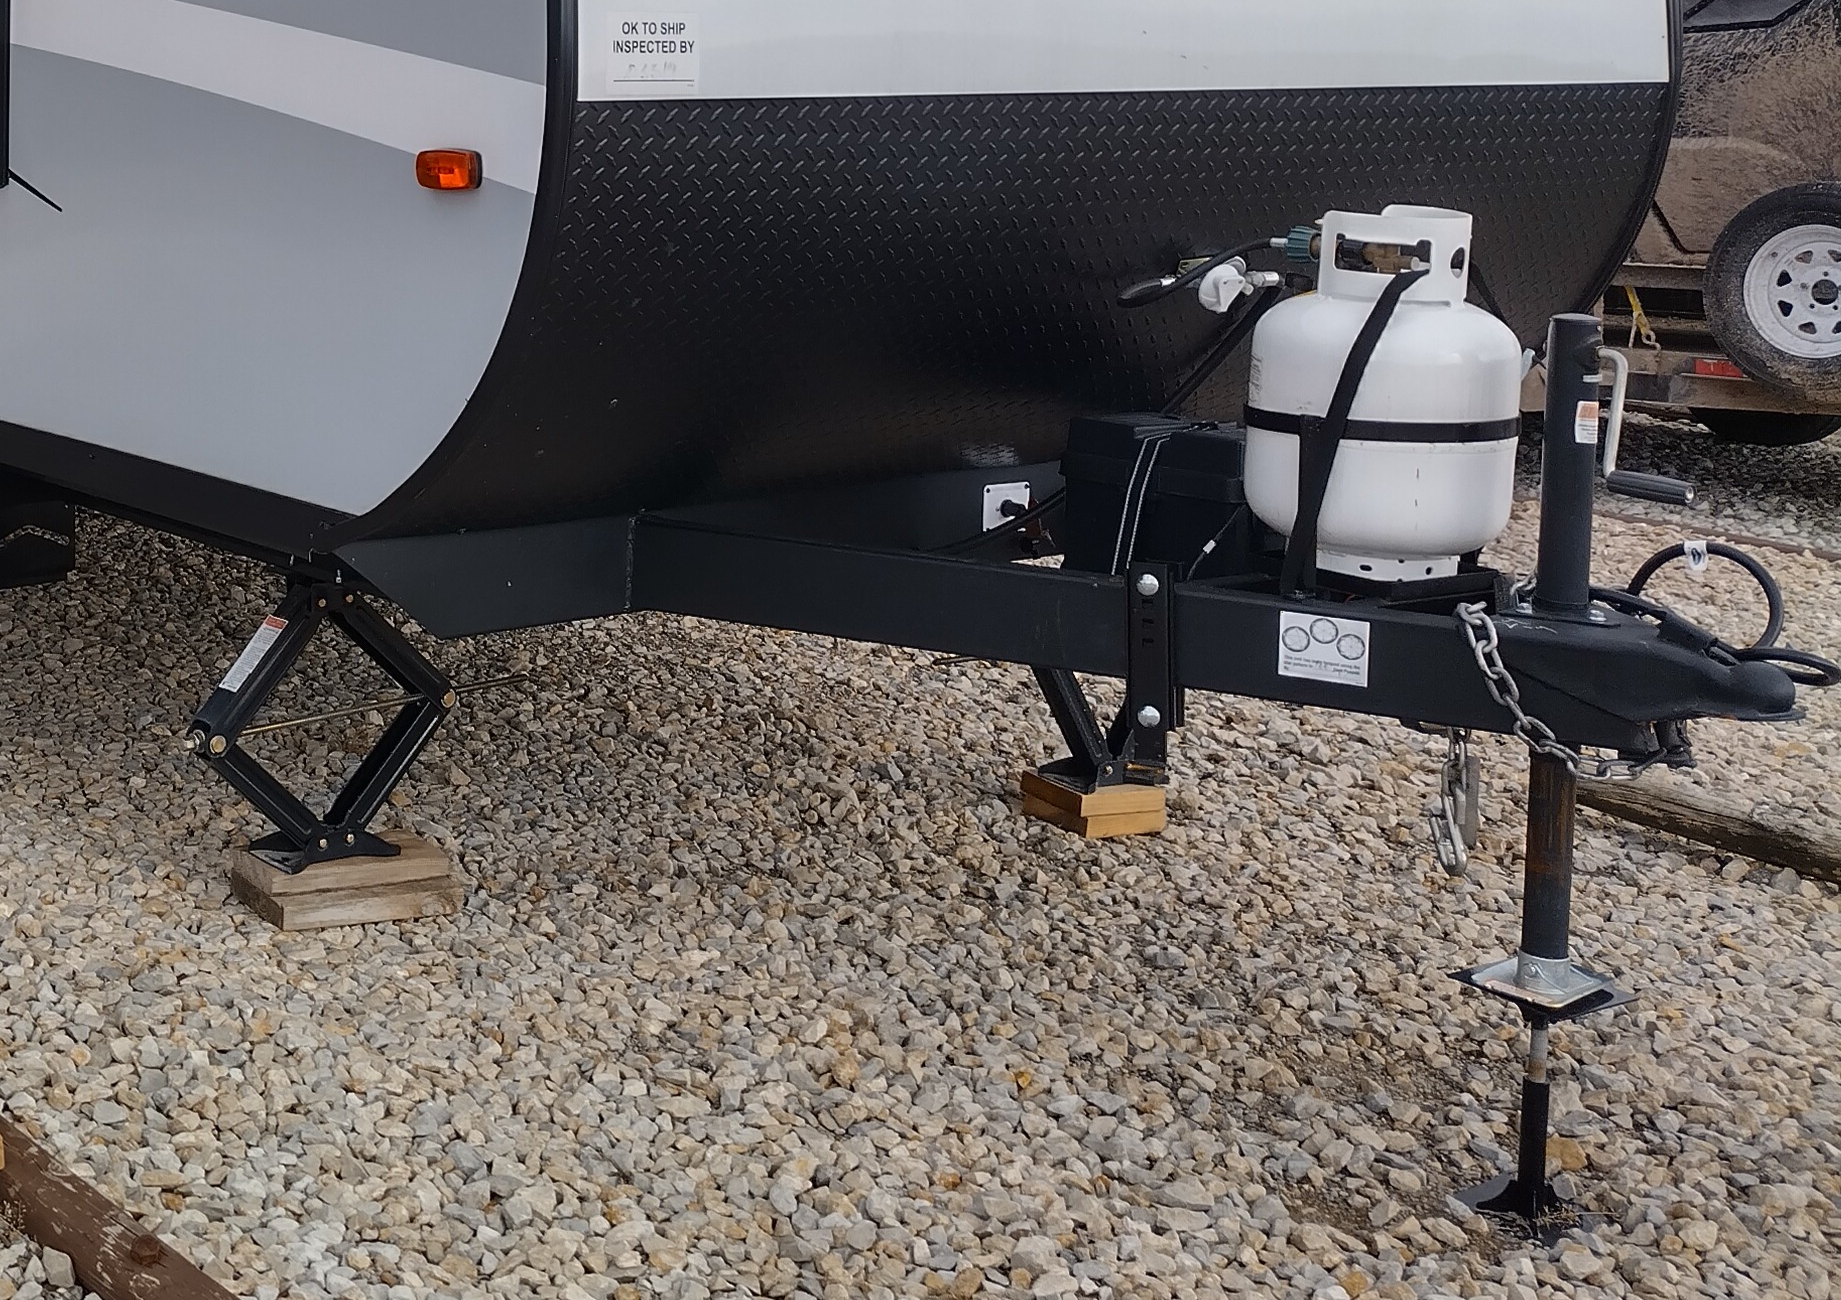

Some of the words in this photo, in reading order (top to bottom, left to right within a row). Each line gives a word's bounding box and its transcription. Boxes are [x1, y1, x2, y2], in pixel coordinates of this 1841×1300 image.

[622, 22, 639, 35] OK
[642, 22, 657, 35] TO
[660, 22, 686, 35] SHIP
[612, 40, 677, 53] INSPECTED
[680, 40, 695, 53] BY
